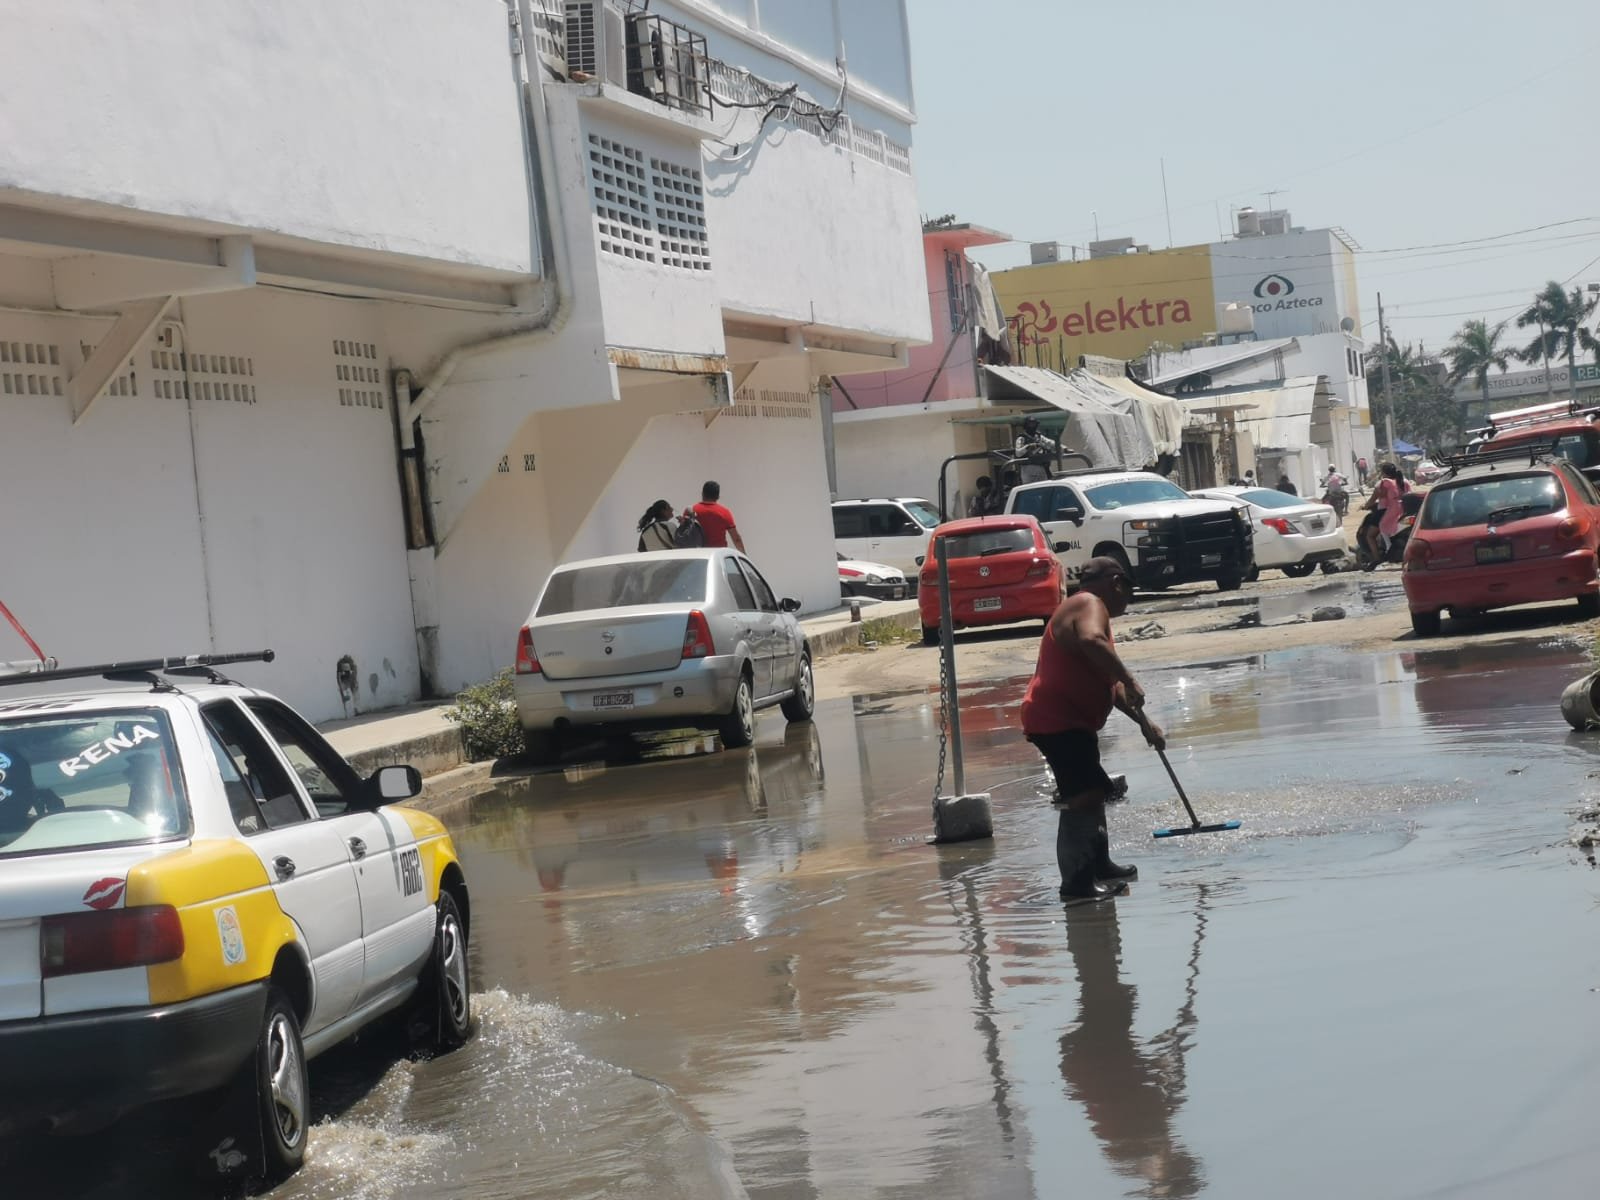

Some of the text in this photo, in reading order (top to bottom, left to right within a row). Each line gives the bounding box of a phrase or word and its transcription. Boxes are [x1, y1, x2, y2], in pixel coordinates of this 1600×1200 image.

[1062, 296, 1192, 337] elektra
[1275, 297, 1323, 311] Azteca
[1487, 379, 1529, 389] STRELLA
[59, 724, 160, 777] RENA
